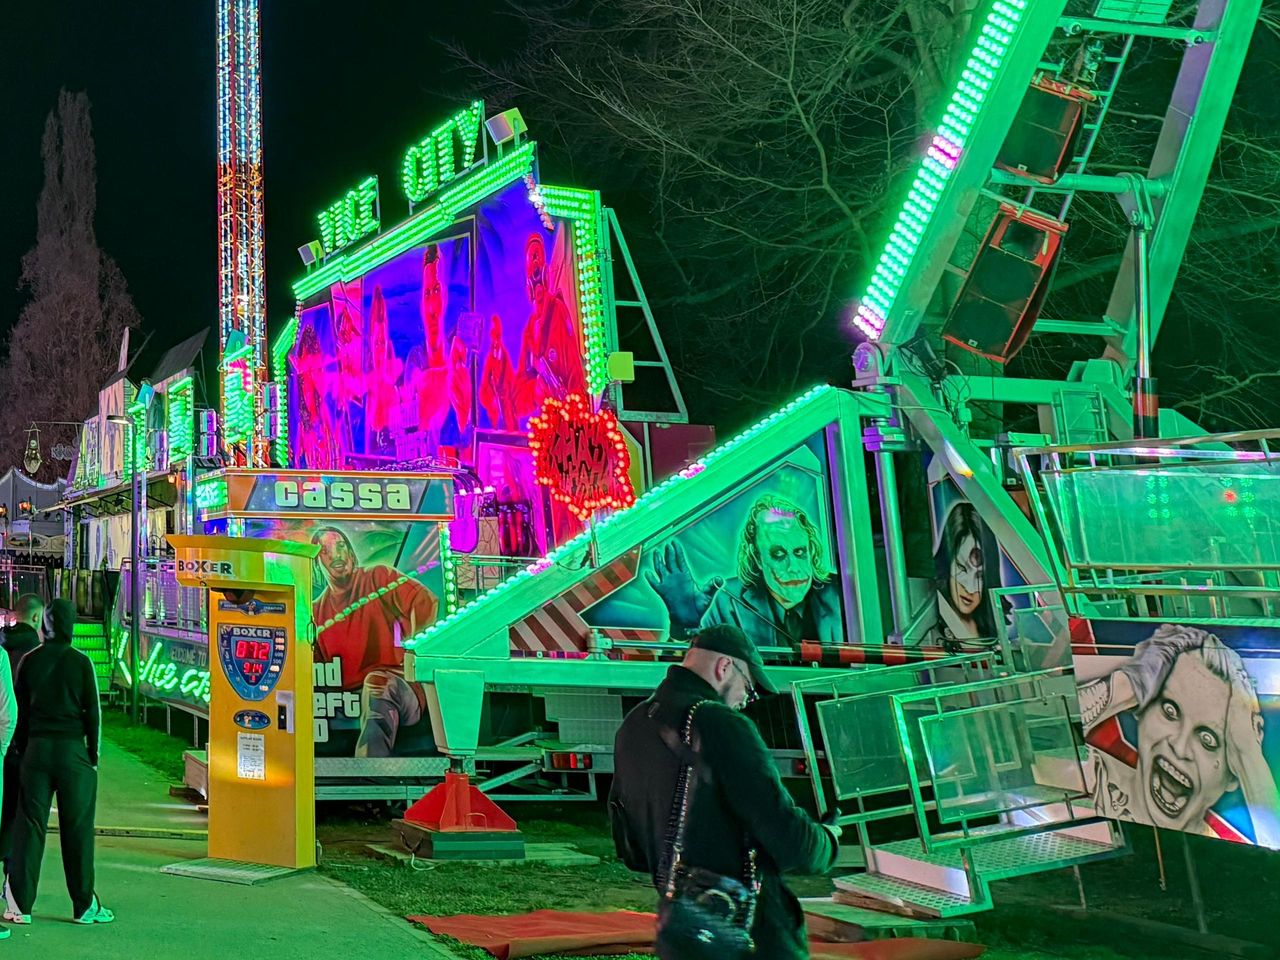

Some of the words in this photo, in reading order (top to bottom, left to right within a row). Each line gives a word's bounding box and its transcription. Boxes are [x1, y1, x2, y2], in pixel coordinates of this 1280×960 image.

[318, 175, 379, 253] VICE
[402, 100, 482, 202] CITY
[274, 481, 410, 510] cassa
[178, 560, 233, 575] BOXER
[233, 627, 271, 638] BOXER
[236, 640, 271, 661] 872
[243, 662, 263, 674] 914
[313, 656, 342, 687] nd
[313, 691, 360, 718] eft
